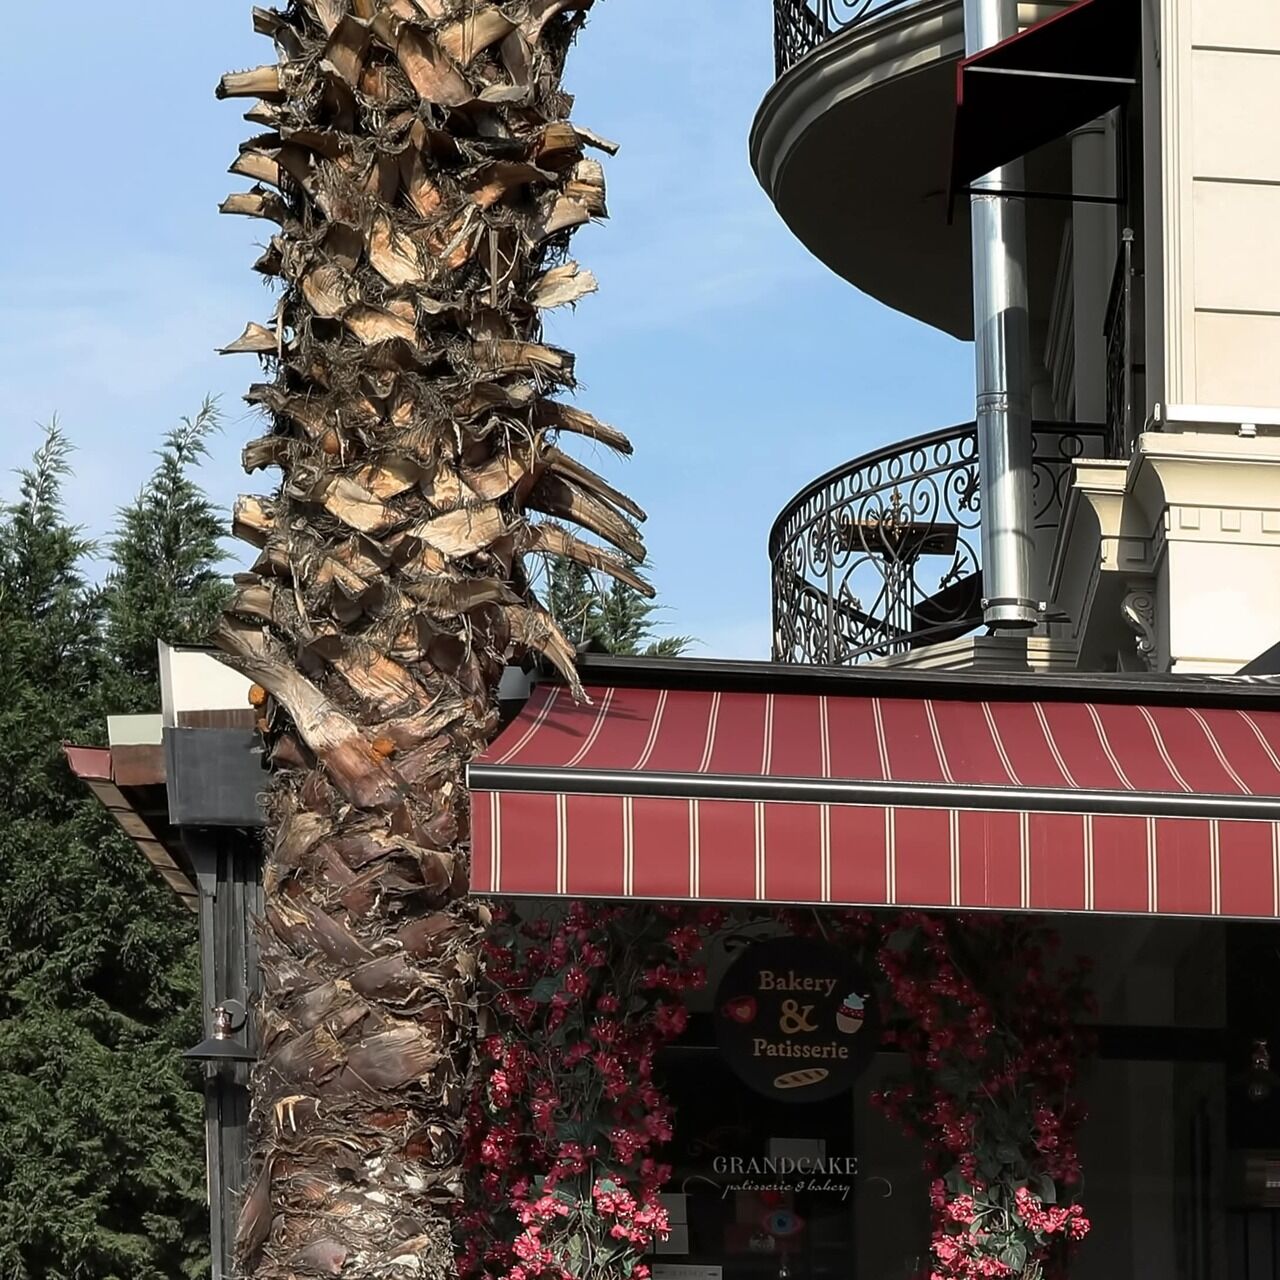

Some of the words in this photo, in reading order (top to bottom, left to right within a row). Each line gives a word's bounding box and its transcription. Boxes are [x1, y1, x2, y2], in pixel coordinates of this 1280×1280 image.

[758, 970, 838, 997] Bakery
[779, 999, 819, 1034] &
[752, 1038, 849, 1060] Patisserie
[712, 1155, 858, 1176] GRANDCAKE
[721, 1179, 792, 1200] patisserie
[806, 1178, 852, 1201] bakery
